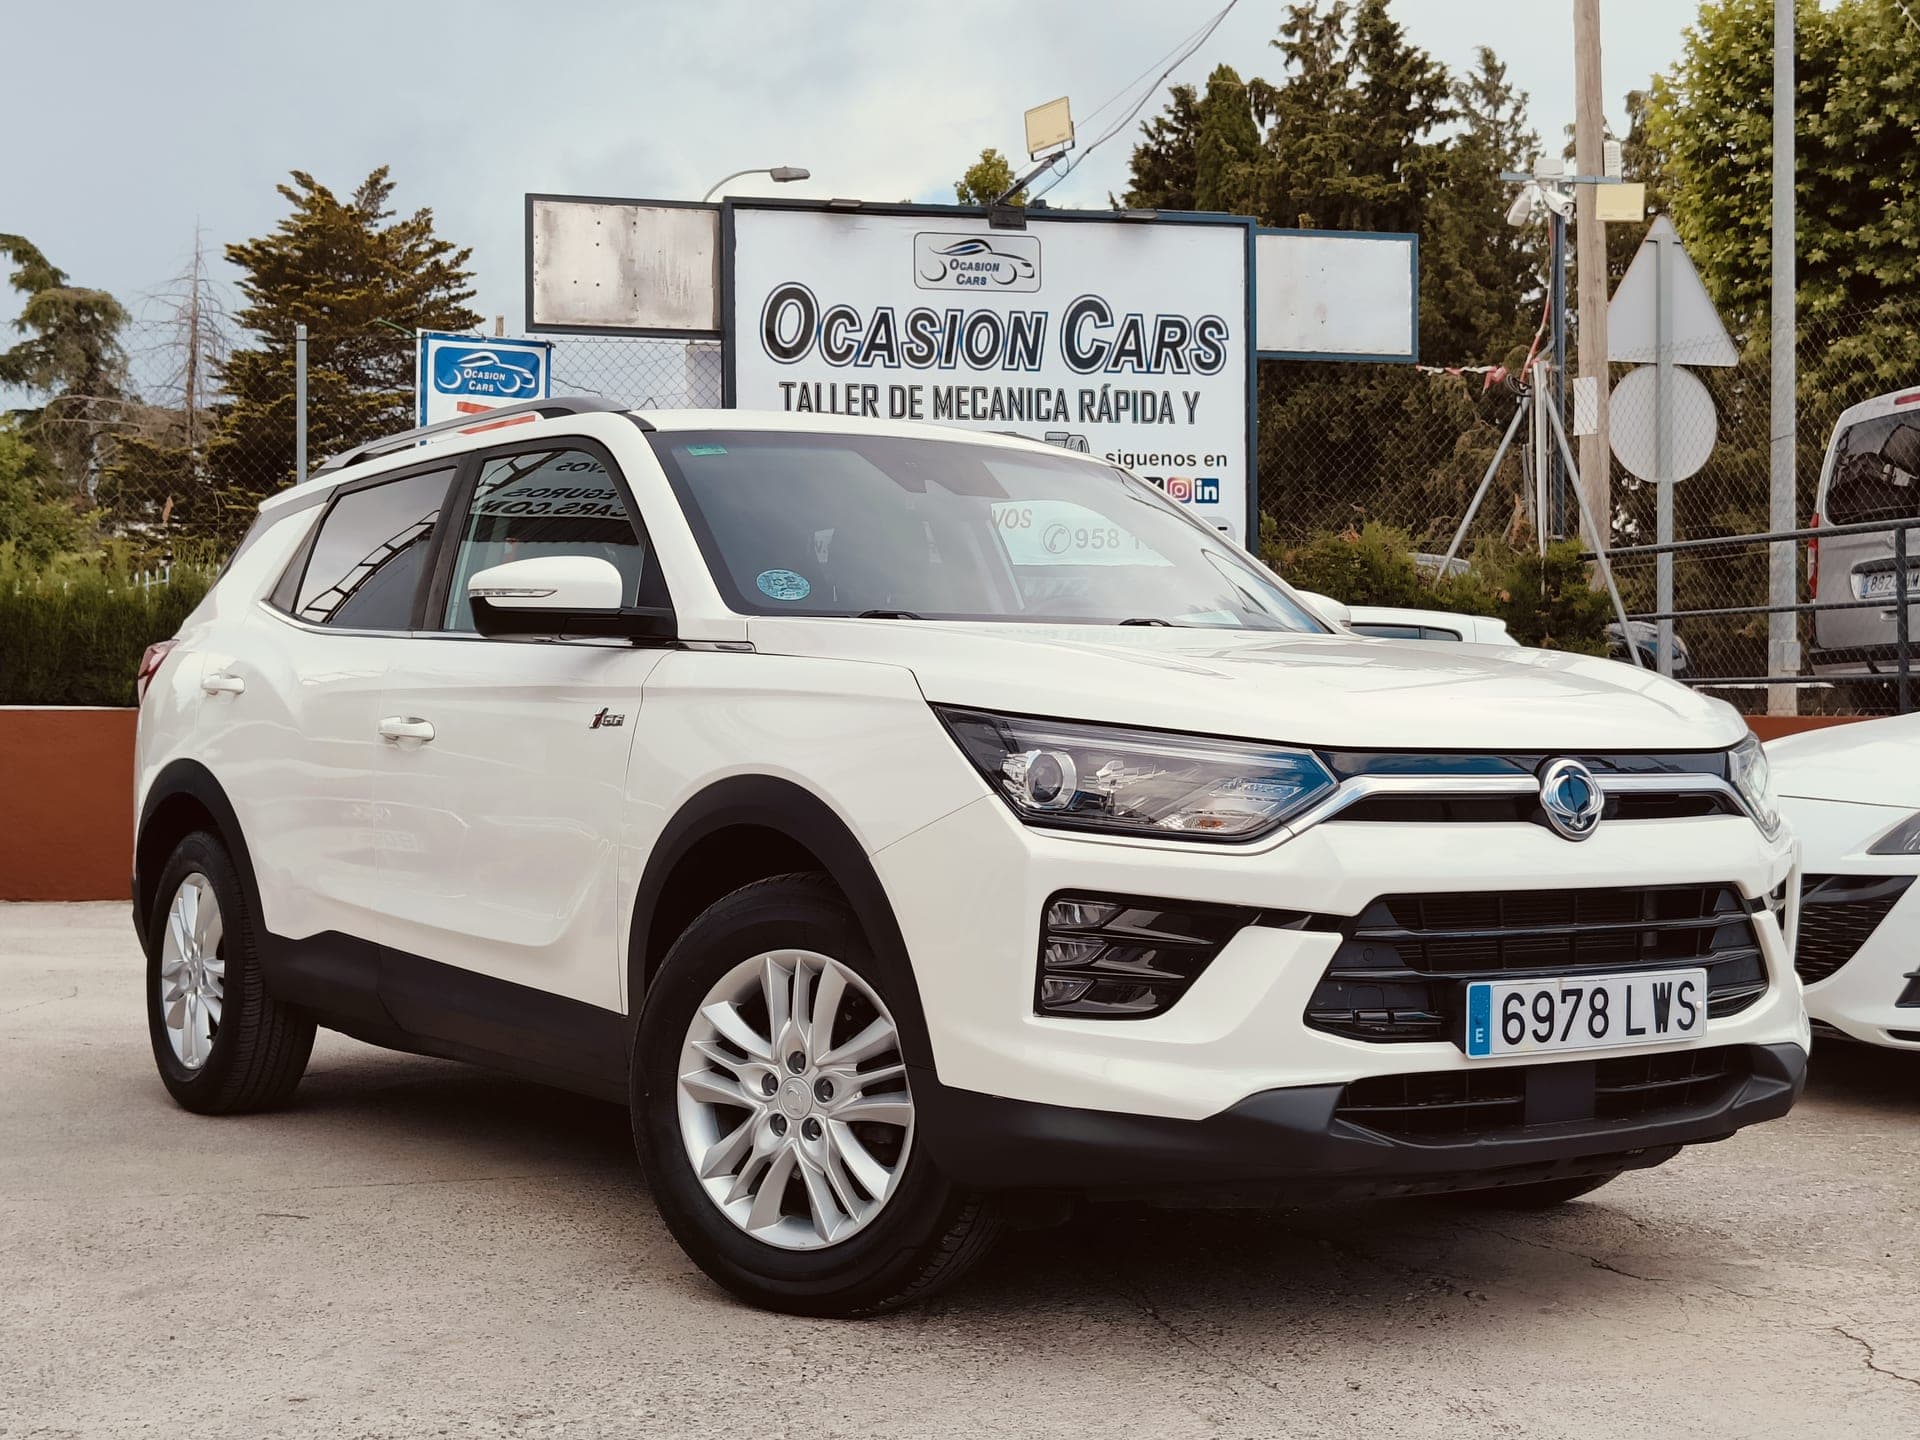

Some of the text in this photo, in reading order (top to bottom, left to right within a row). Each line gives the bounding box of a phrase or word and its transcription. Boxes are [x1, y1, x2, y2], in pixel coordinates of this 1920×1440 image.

[949, 258, 1000, 273] OCASION
[956, 273, 987, 286] CARS
[760, 282, 1229, 375] OCASION CARS
[464, 368, 506, 381] OCASION
[468, 380, 494, 392] CARS
[779, 381, 1200, 425] TALLER DE MECANICA RÁPIDA Y
[1105, 449, 1227, 469] siguenos en
[1075, 528, 1121, 549] 958
[1475, 980, 1696, 1045] E 6978 LWS
